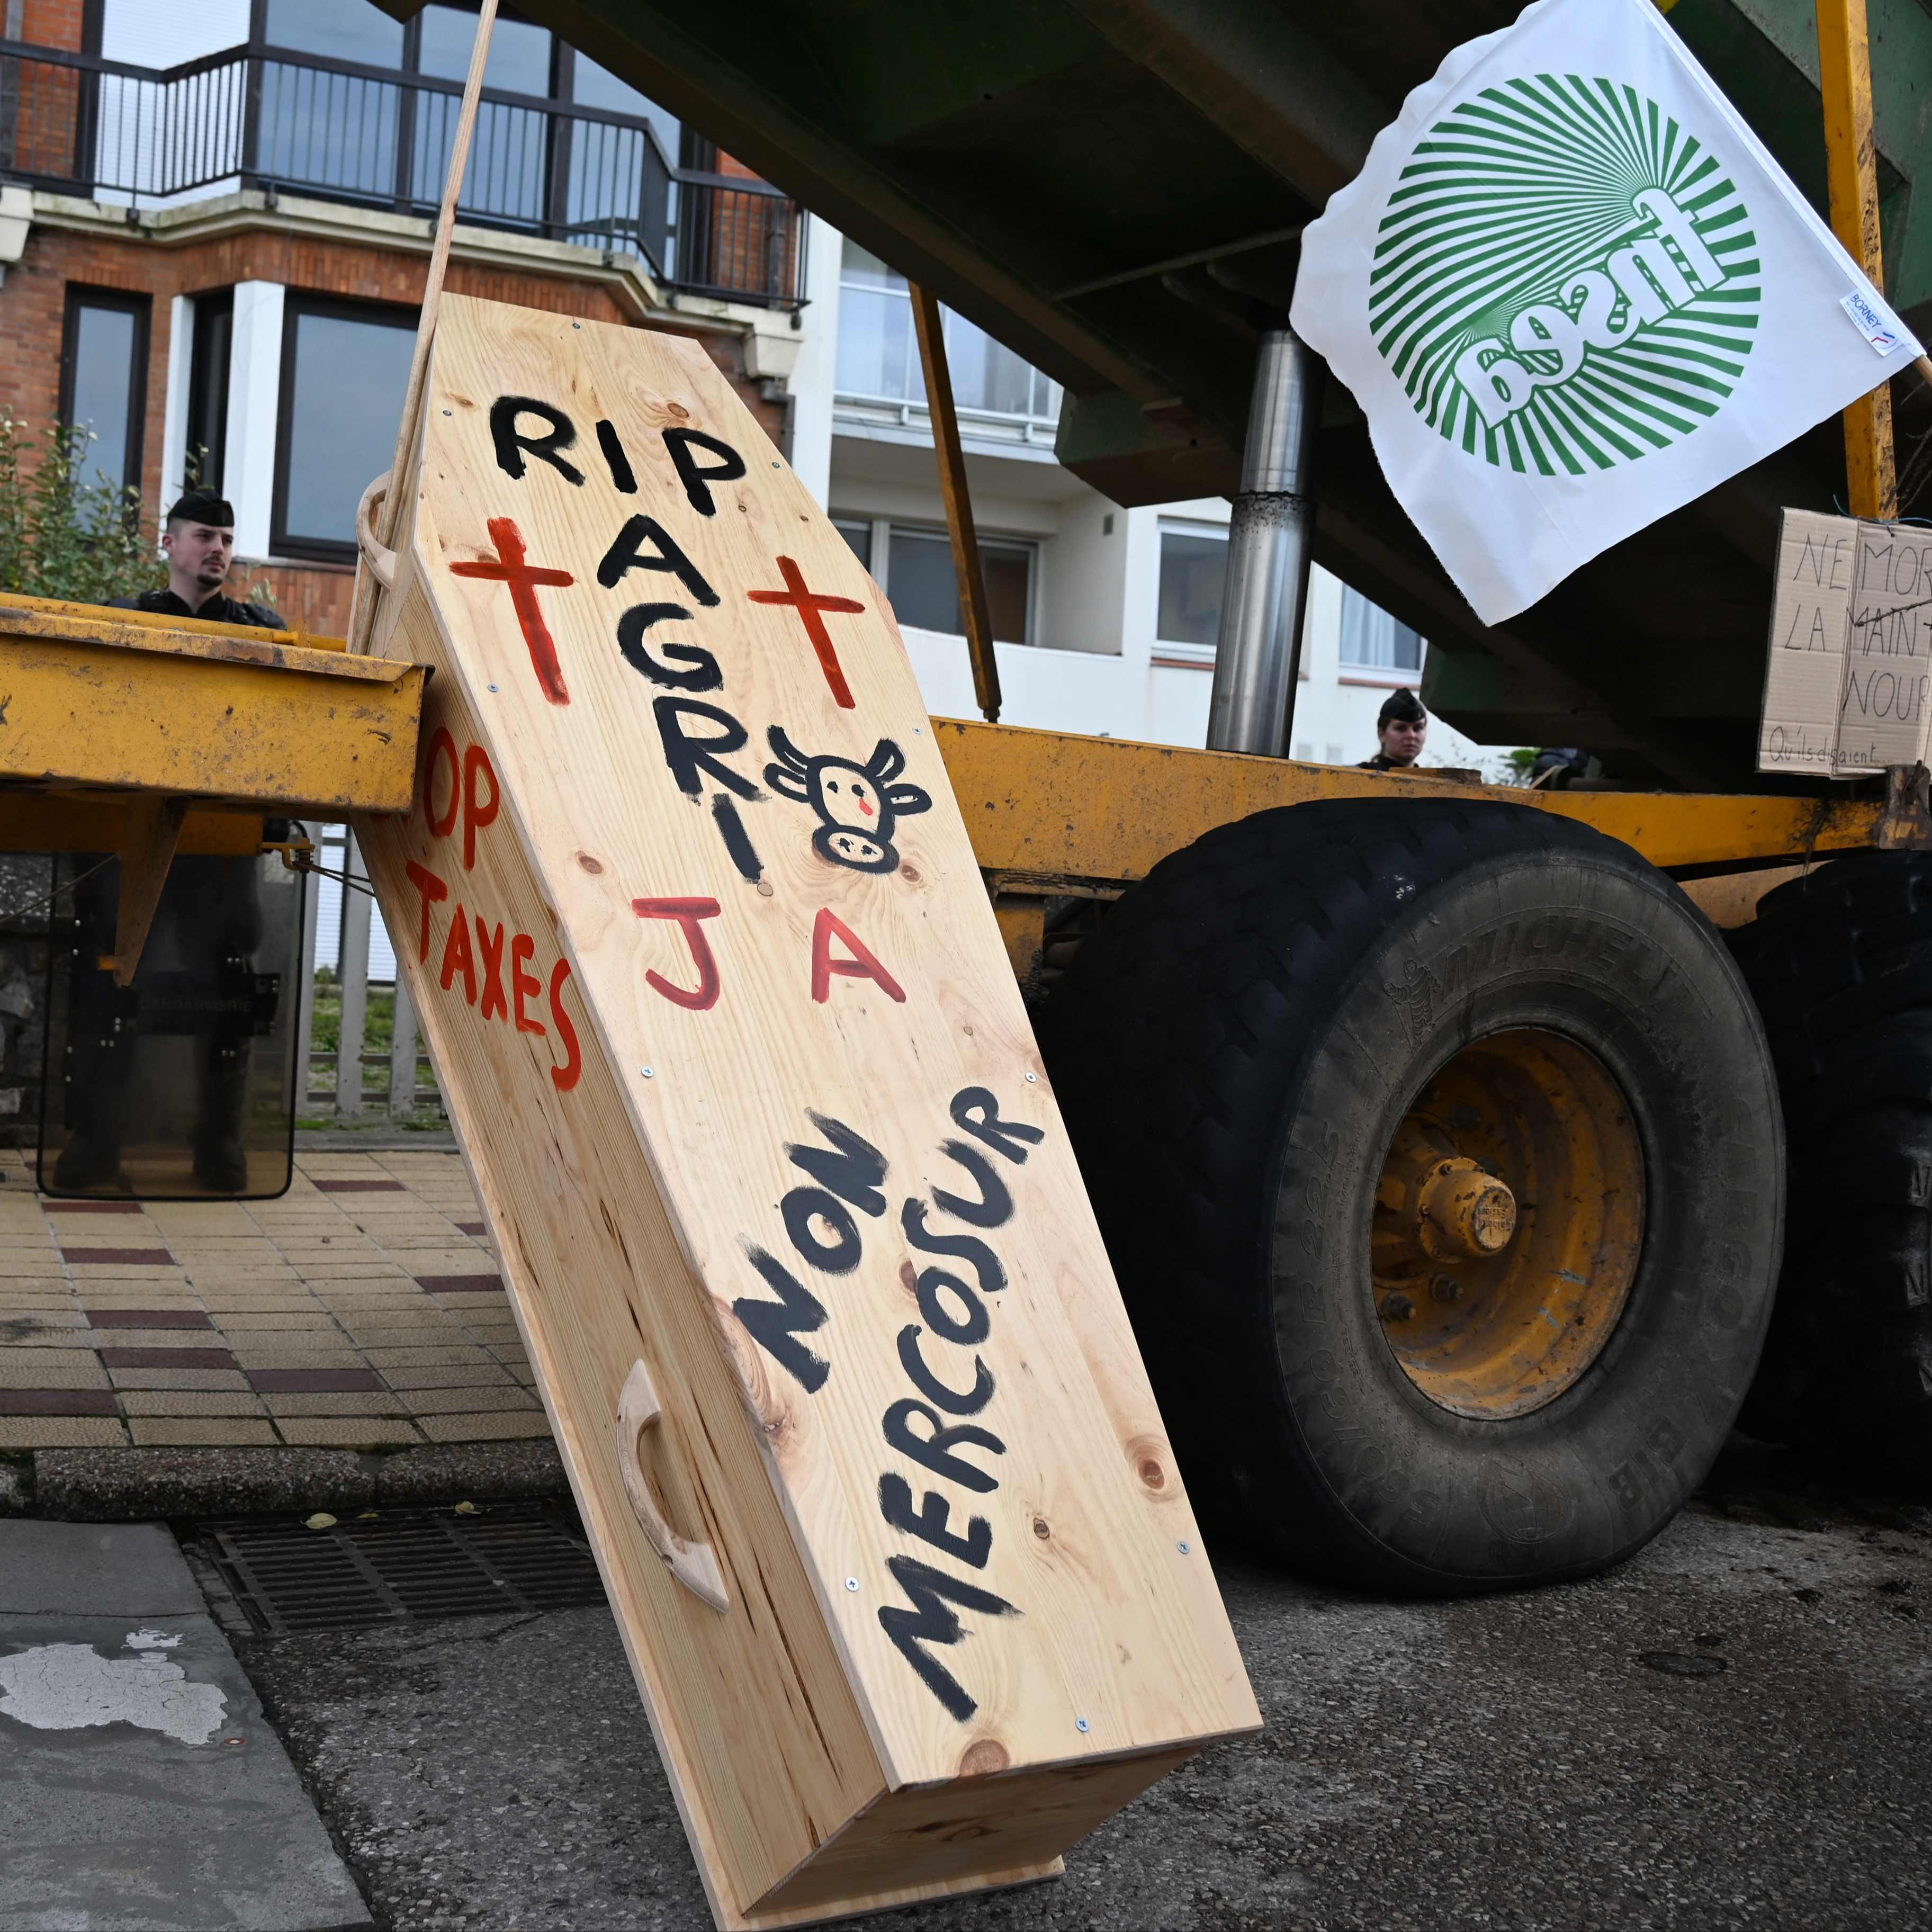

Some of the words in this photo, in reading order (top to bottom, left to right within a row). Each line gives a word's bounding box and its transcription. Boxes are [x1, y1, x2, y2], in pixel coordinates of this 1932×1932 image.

[1850, 294, 1882, 328] BORNEY
[490, 395, 745, 517] RIP
[1793, 534, 1847, 590] NE
[1784, 604, 1825, 652] LA
[1846, 606, 1917, 656] MAIN
[597, 514, 771, 883] AGRI
[372, 726, 499, 871] OP
[406, 860, 581, 1092] TAXES
[1443, 914, 1702, 1017] MICHEL
[731, 1106, 889, 1394] NON
[876, 1085, 1045, 1723] MERCOSUR
